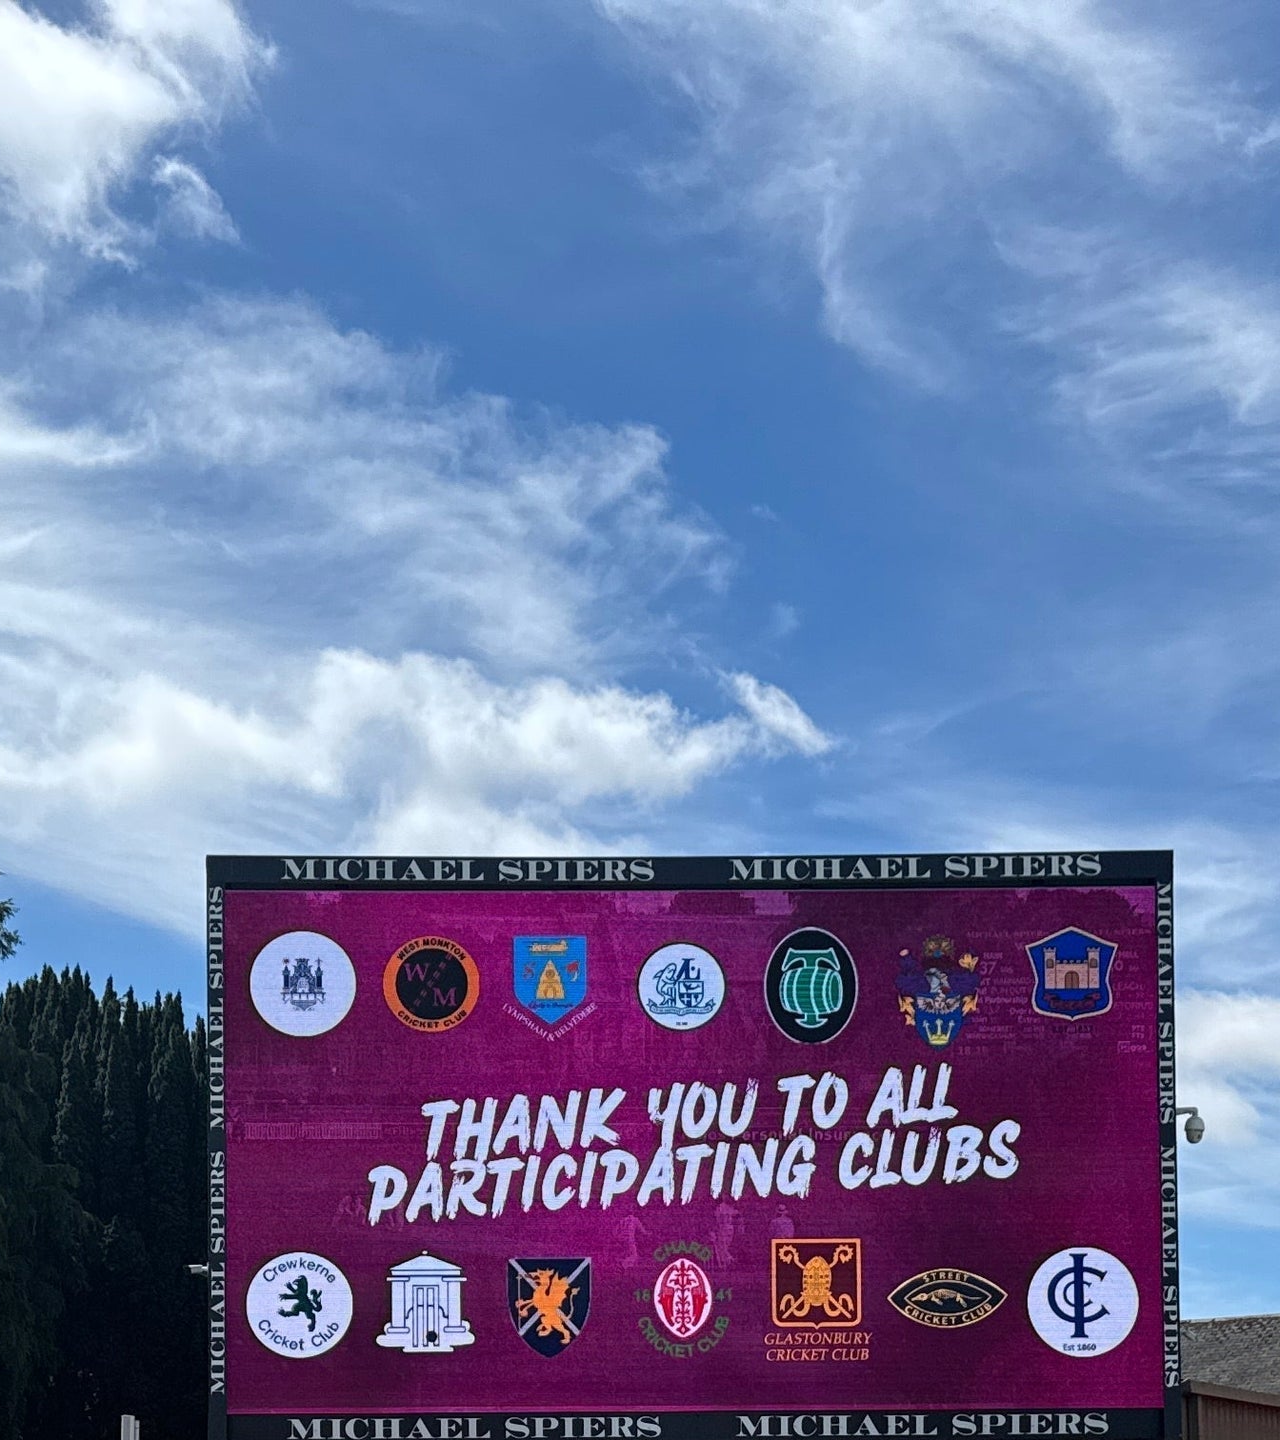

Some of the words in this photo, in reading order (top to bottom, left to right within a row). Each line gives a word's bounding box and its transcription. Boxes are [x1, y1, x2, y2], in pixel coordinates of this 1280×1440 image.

[281, 859, 484, 881] MICHAEL
[498, 859, 656, 882] SPIERS
[728, 857, 931, 880] MICHAEL
[944, 854, 1103, 878] SPIERS
[209, 886, 224, 990] SPIERS
[396, 940, 422, 961] WEST
[422, 937, 466, 961] MONKTON
[1157, 882, 1172, 1013] MICHAEL
[397, 1010, 439, 1029] CRICKET
[443, 1009, 467, 1028] CLUB
[503, 1003, 547, 1039] LYMPSHAM
[210, 999, 225, 1129] MICHAEL
[1159, 1022, 1174, 1124] SPIERS
[421, 1087, 626, 1162] THANK
[648, 1077, 760, 1148] YOU
[777, 1070, 849, 1138] TO
[866, 1062, 958, 1127] ALL
[367, 1136, 818, 1226] PARTICIPATING
[838, 1119, 1022, 1191] CLUBS
[210, 1151, 225, 1254] SPIERS
[1160, 1145, 1177, 1277] MICHAEL
[654, 1240, 712, 1262] CHARD
[262, 1257, 337, 1283] Crewkerne
[923, 1271, 970, 1283] STREET
[210, 1262, 226, 1394] MICHAEL
[904, 1305, 956, 1325] CRICKET
[961, 1302, 993, 1322] CLUB
[258, 1319, 304, 1351] Cricket
[311, 1320, 340, 1347] Club
[638, 1316, 695, 1358] CRICKET
[697, 1316, 730, 1353] CLUB
[764, 1332, 872, 1346] GLASTONBURY
[1163, 1286, 1180, 1388] SPIERS
[766, 1348, 829, 1361] CRICKET
[831, 1348, 870, 1361] CLUB
[287, 1417, 491, 1440] MICHAEL
[505, 1416, 662, 1439] SPIERS
[735, 1413, 938, 1437] MICHAEL
[951, 1412, 1110, 1436] SPIERS
